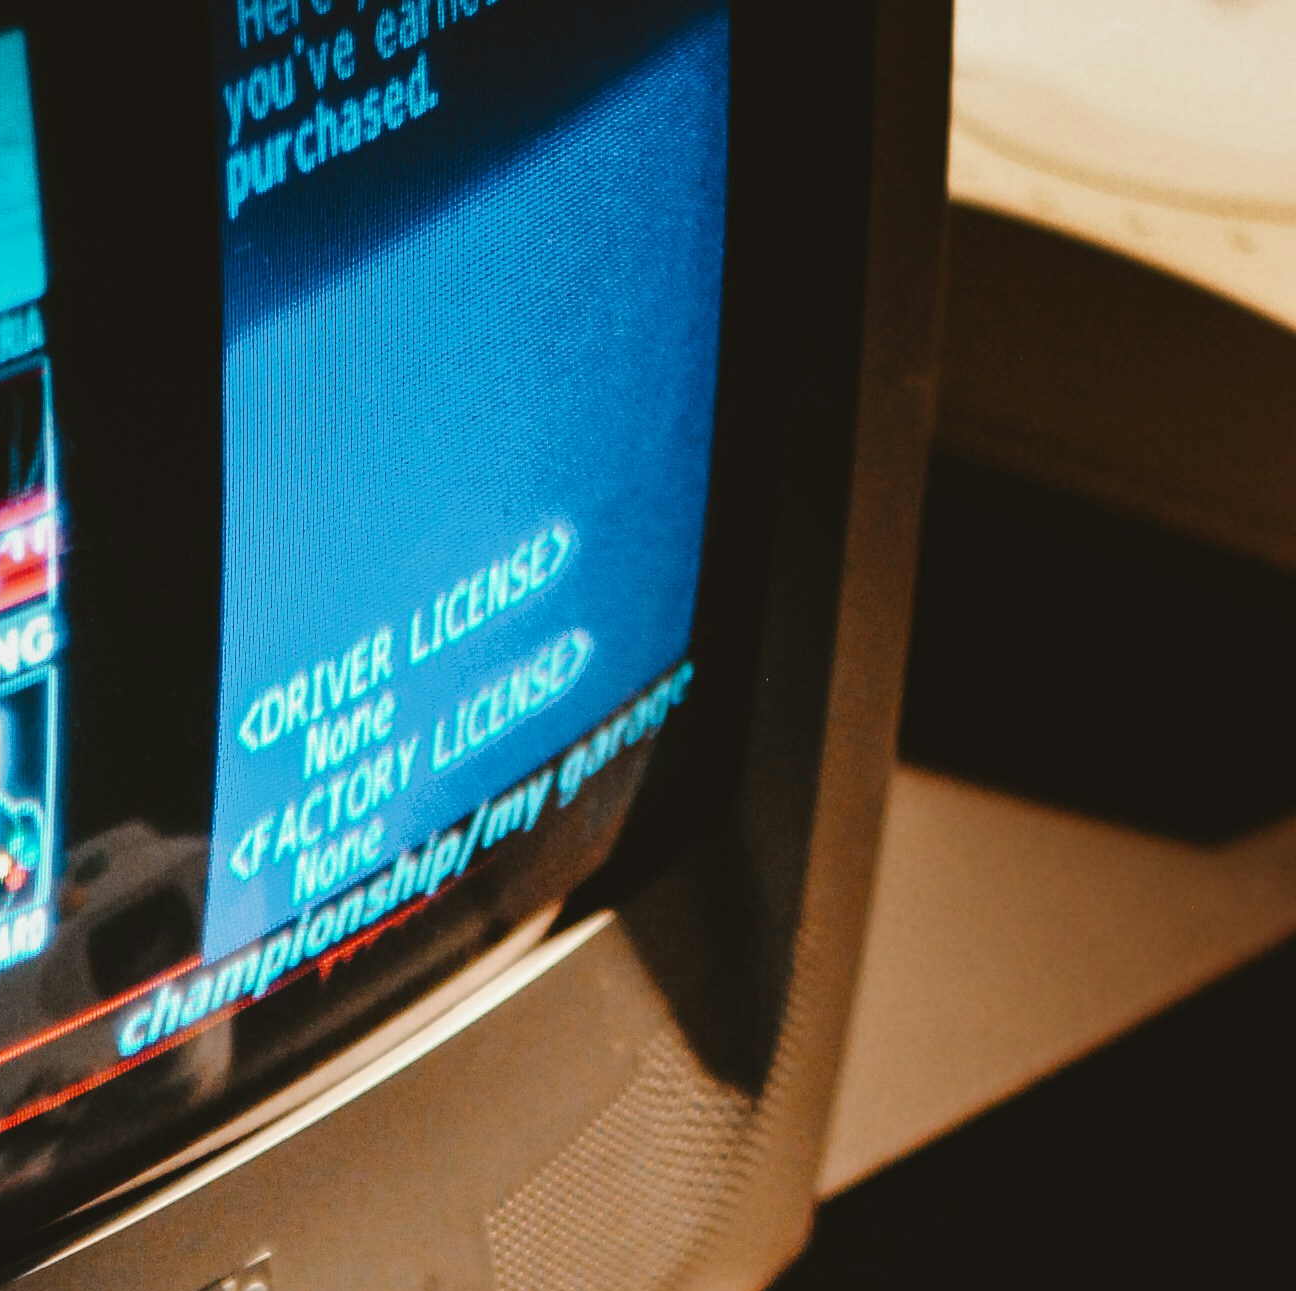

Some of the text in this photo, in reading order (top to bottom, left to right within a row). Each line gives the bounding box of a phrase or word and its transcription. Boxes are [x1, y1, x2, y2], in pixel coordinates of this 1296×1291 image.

[237, 0, 333, 49] Her
[223, 0, 496, 146] you've earn
[226, 50, 439, 221] purchased.
[304, 690, 397, 781] None
[293, 816, 386, 907] None
